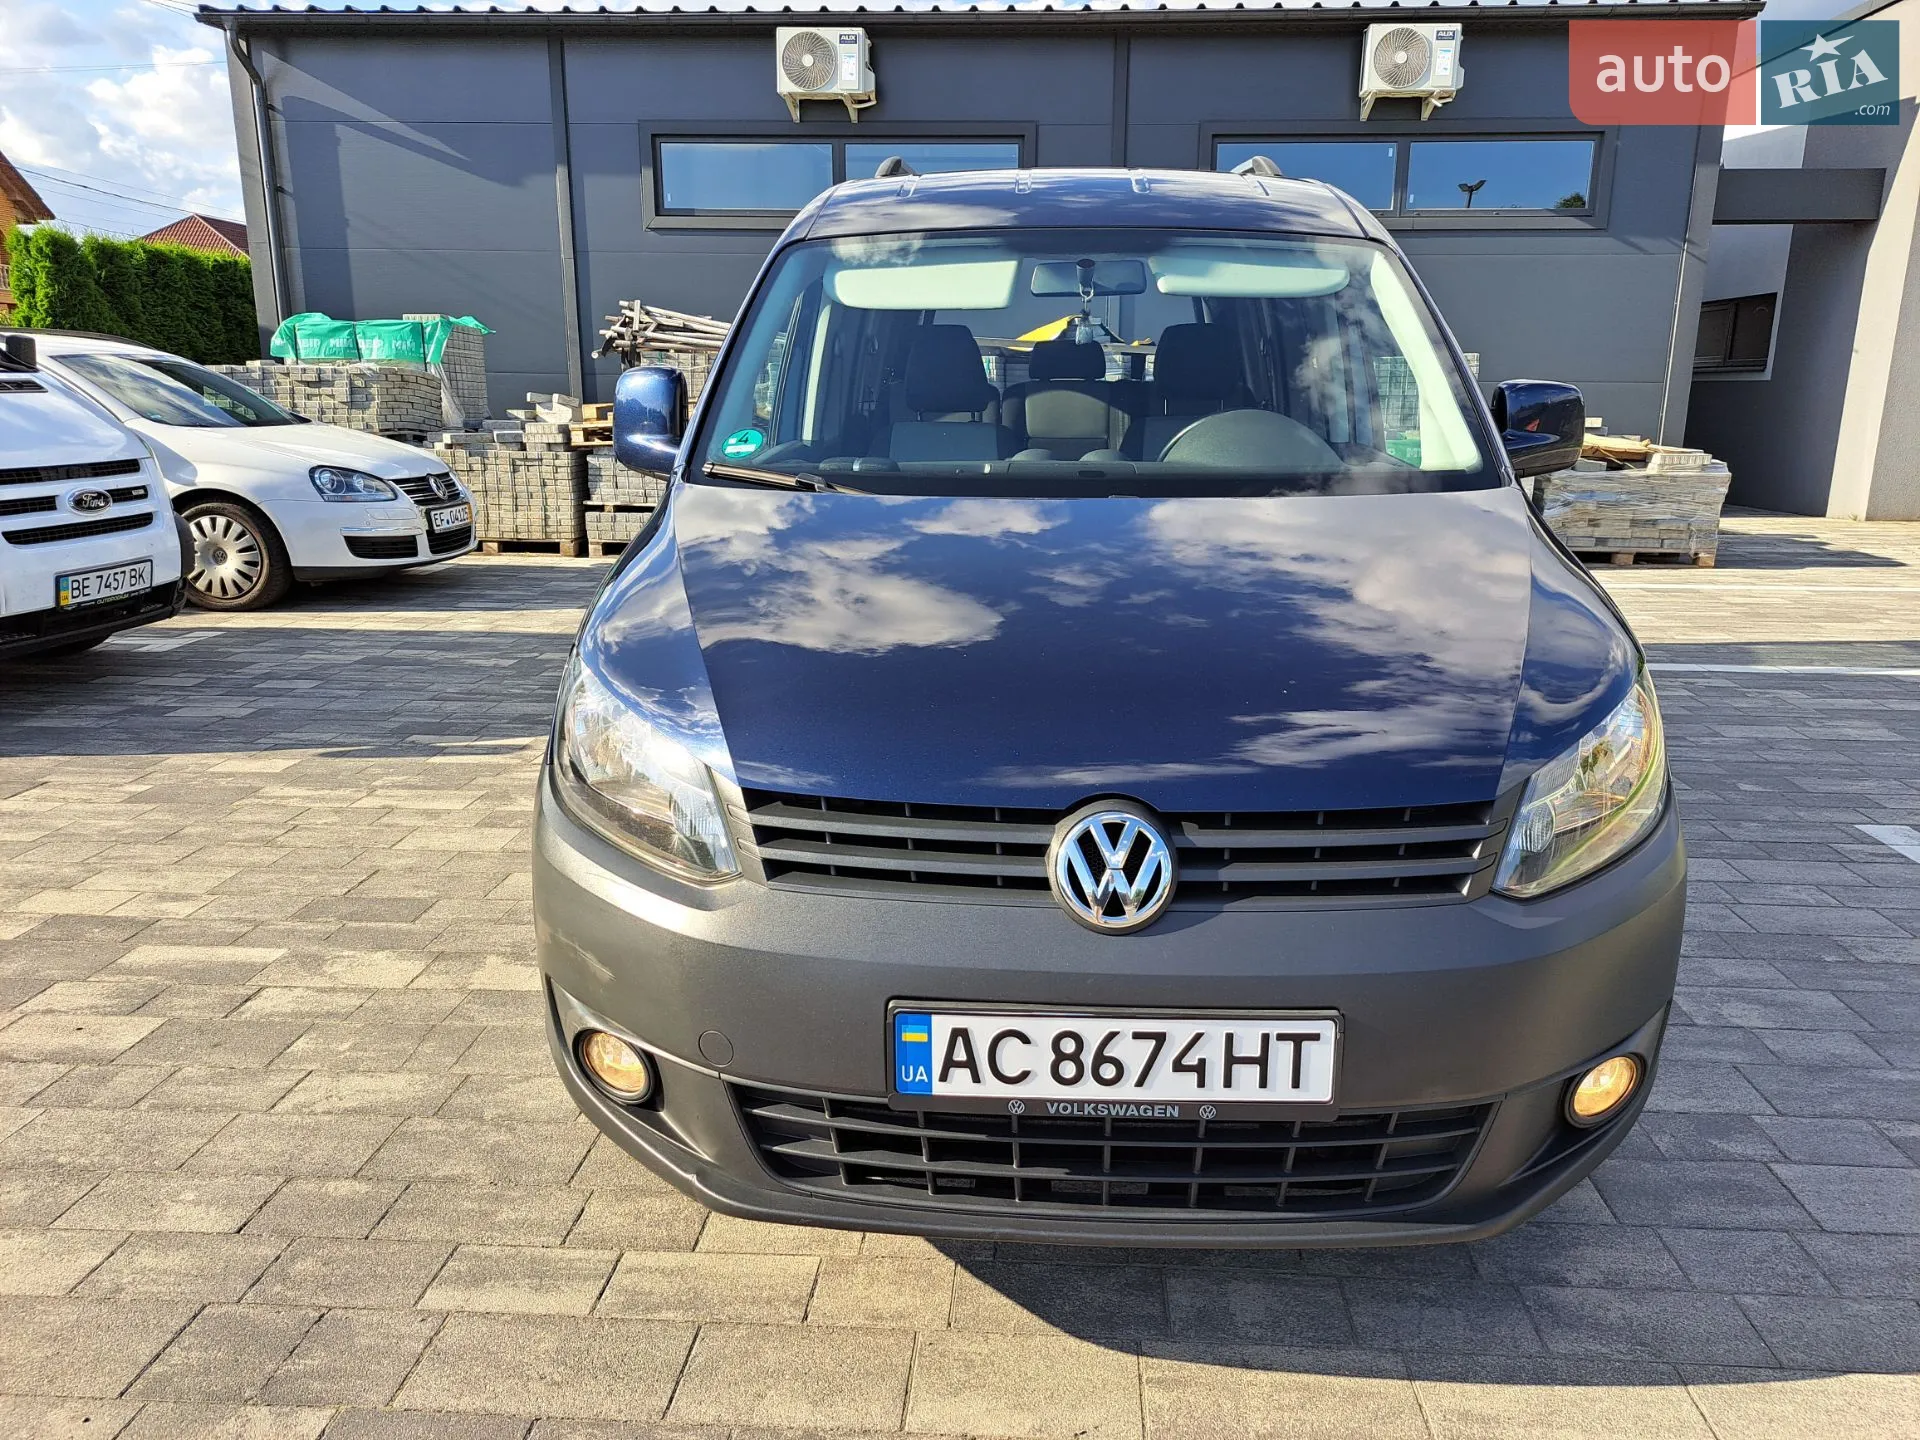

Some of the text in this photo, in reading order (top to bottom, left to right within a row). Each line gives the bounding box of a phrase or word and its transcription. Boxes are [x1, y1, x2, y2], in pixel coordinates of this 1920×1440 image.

[738, 431, 749, 444] 4
[82, 493, 105, 508] Ford
[433, 511, 445, 527] EF
[71, 577, 91, 599] BE
[96, 570, 127, 595] 7457
[129, 566, 147, 587] BK
[937, 1026, 1322, 1090] AC 8674 HT
[901, 1065, 929, 1083] UA
[1046, 1101, 1180, 1118] VOLKSWAGEN
